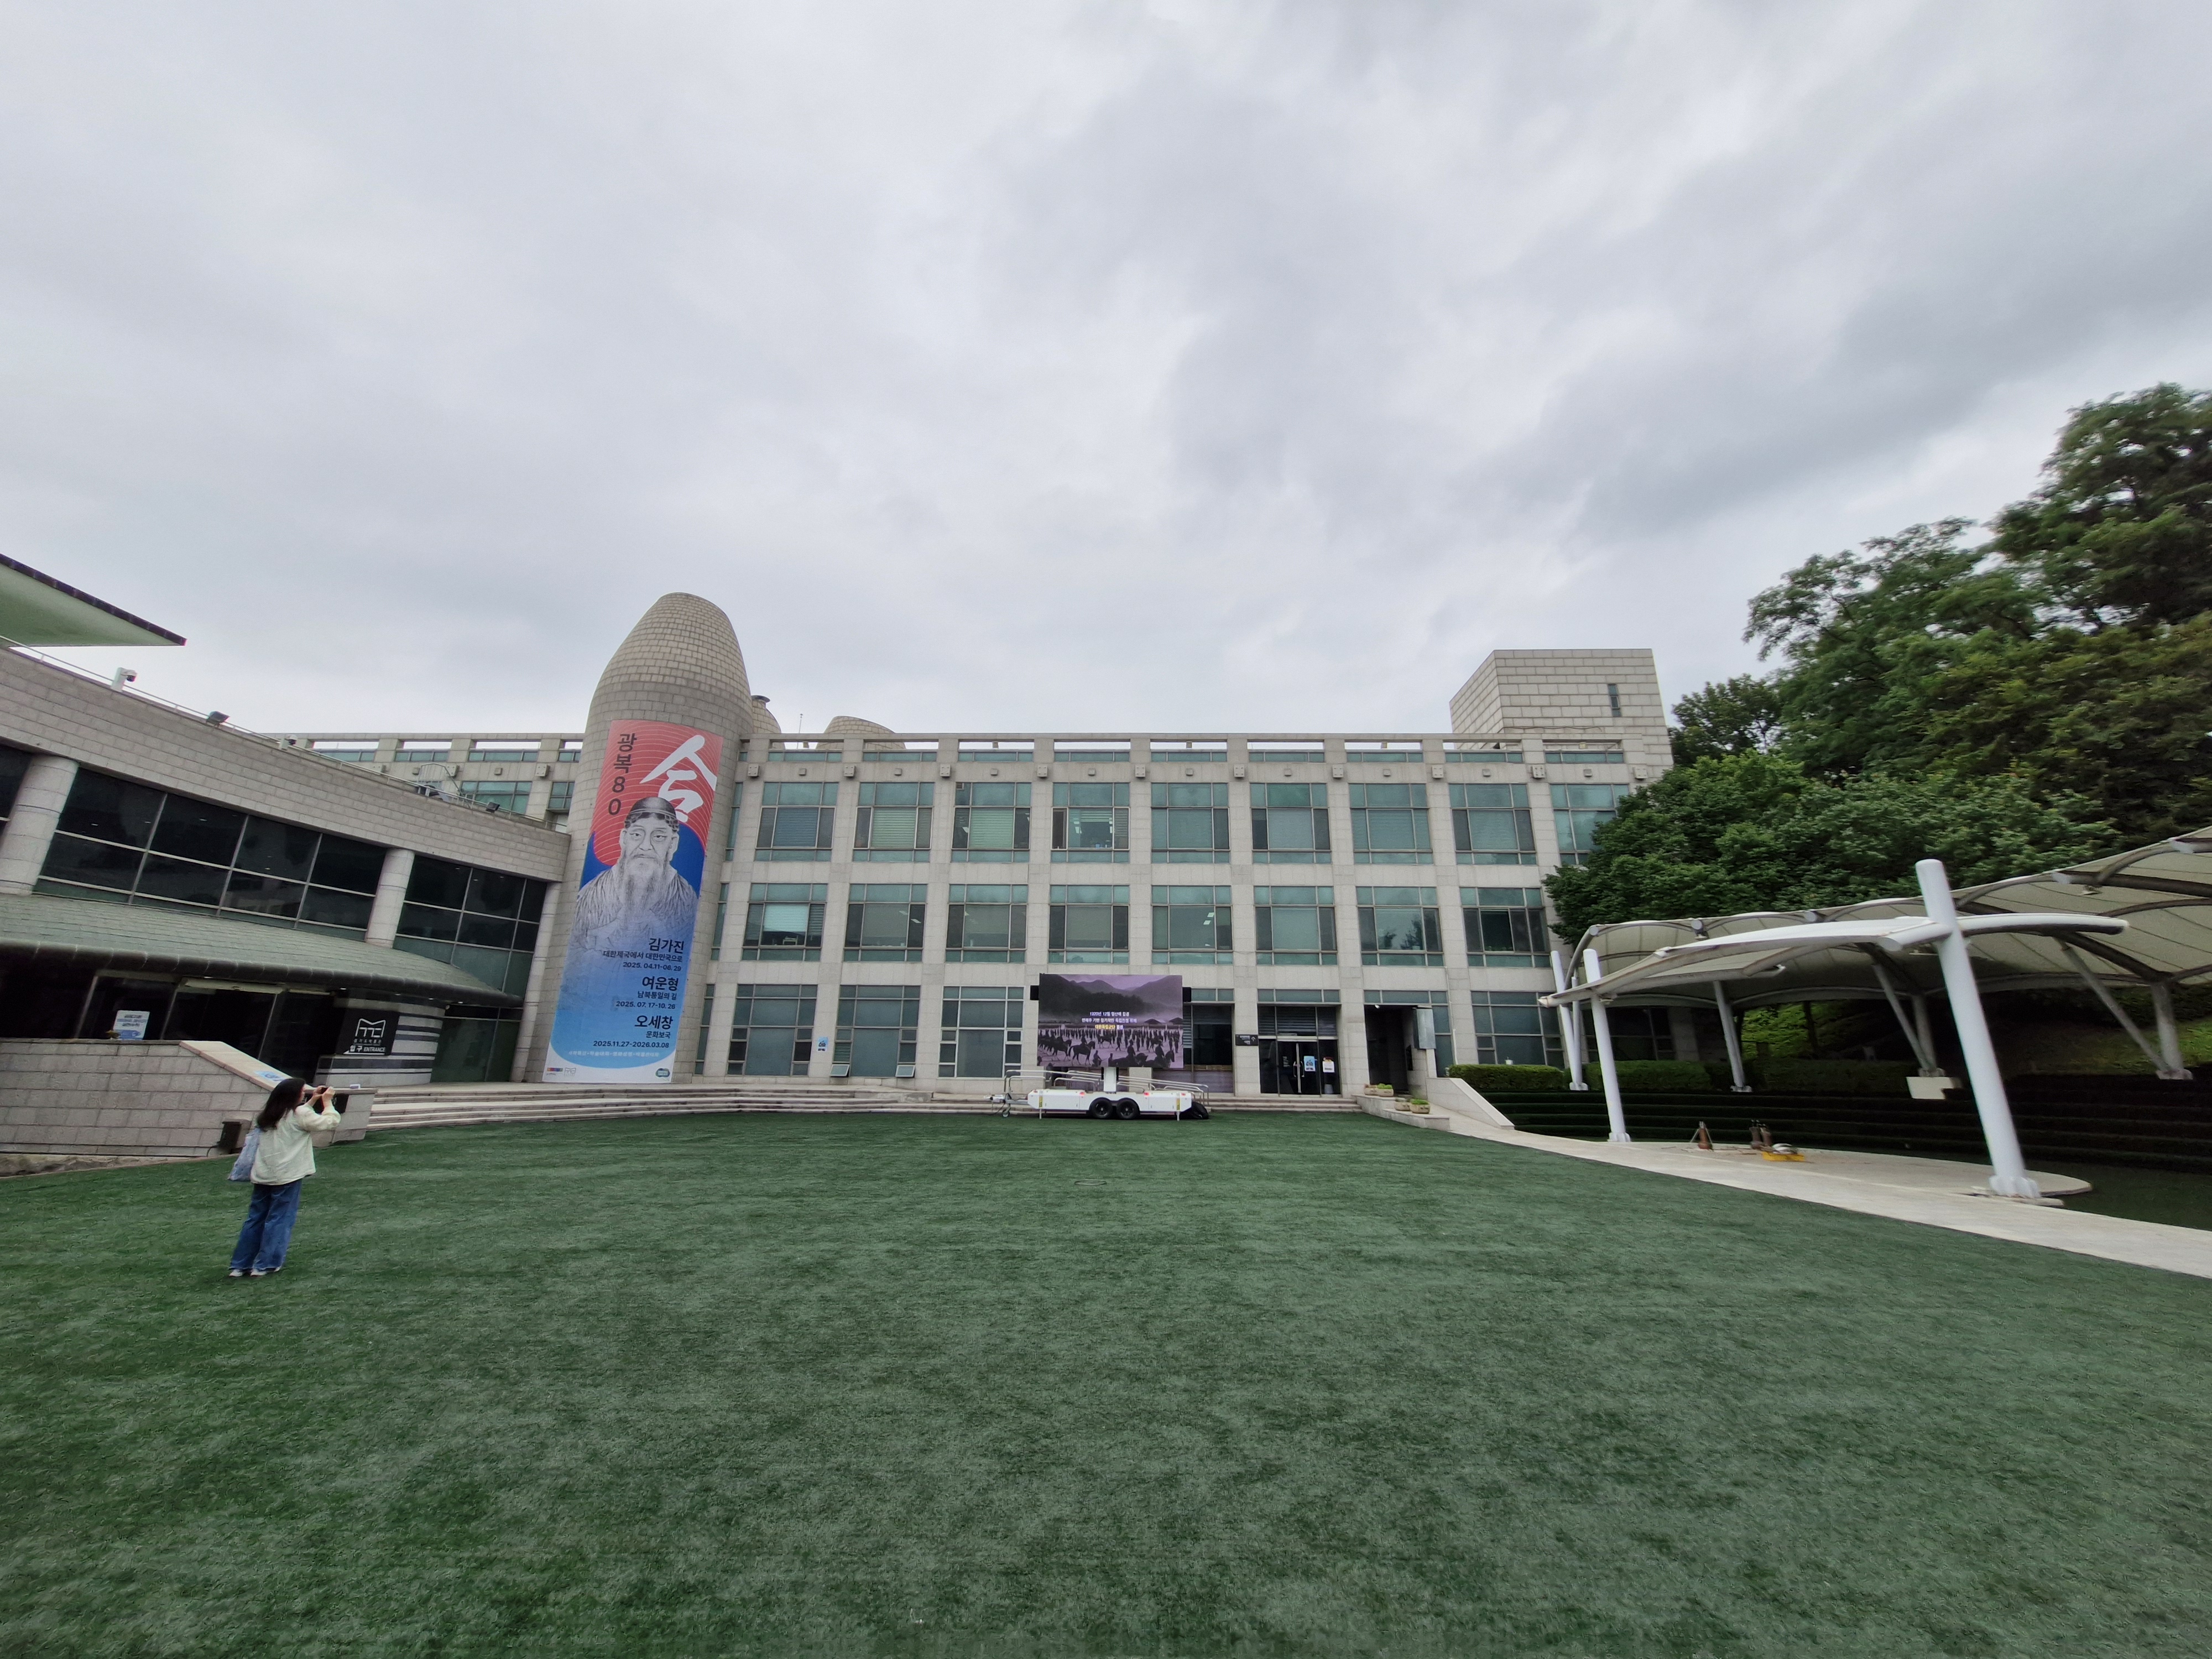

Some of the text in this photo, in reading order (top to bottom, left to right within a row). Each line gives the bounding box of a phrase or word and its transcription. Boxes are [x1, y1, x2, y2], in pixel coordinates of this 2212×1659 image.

[608, 733, 637, 815] 광복80
[649, 937, 685, 954] 김가진
[603, 950, 683, 962] 대한제국에서 대한민국으로
[642, 975, 679, 992] 여운형
[637, 990, 670, 1000] 남북통일의
[634, 1015, 674, 1030] 오세창
[646, 1031, 671, 1039] 문화보국
